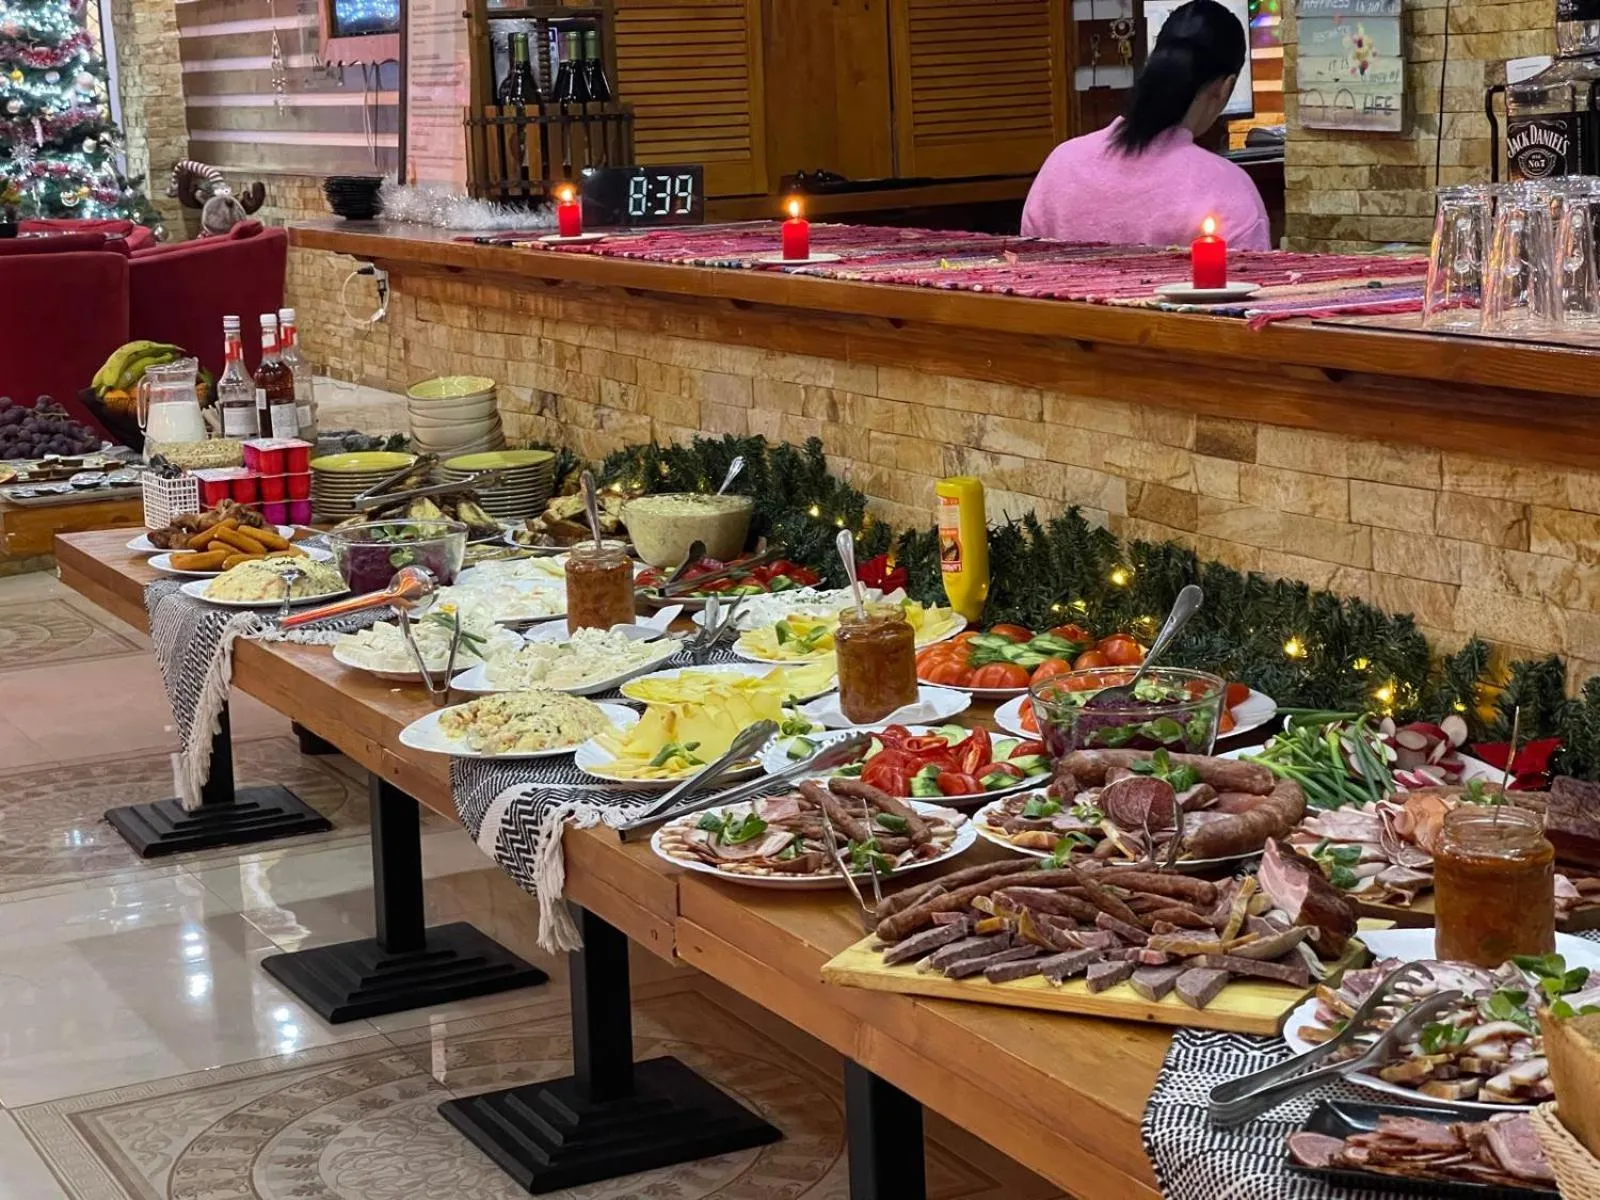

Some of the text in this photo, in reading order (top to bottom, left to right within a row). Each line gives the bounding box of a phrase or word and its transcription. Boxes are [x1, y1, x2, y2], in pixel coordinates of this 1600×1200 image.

[1507, 130, 1530, 159] JACK
[1530, 124, 1571, 156] DANIEL'S
[628, 174, 694, 216] 8:39
